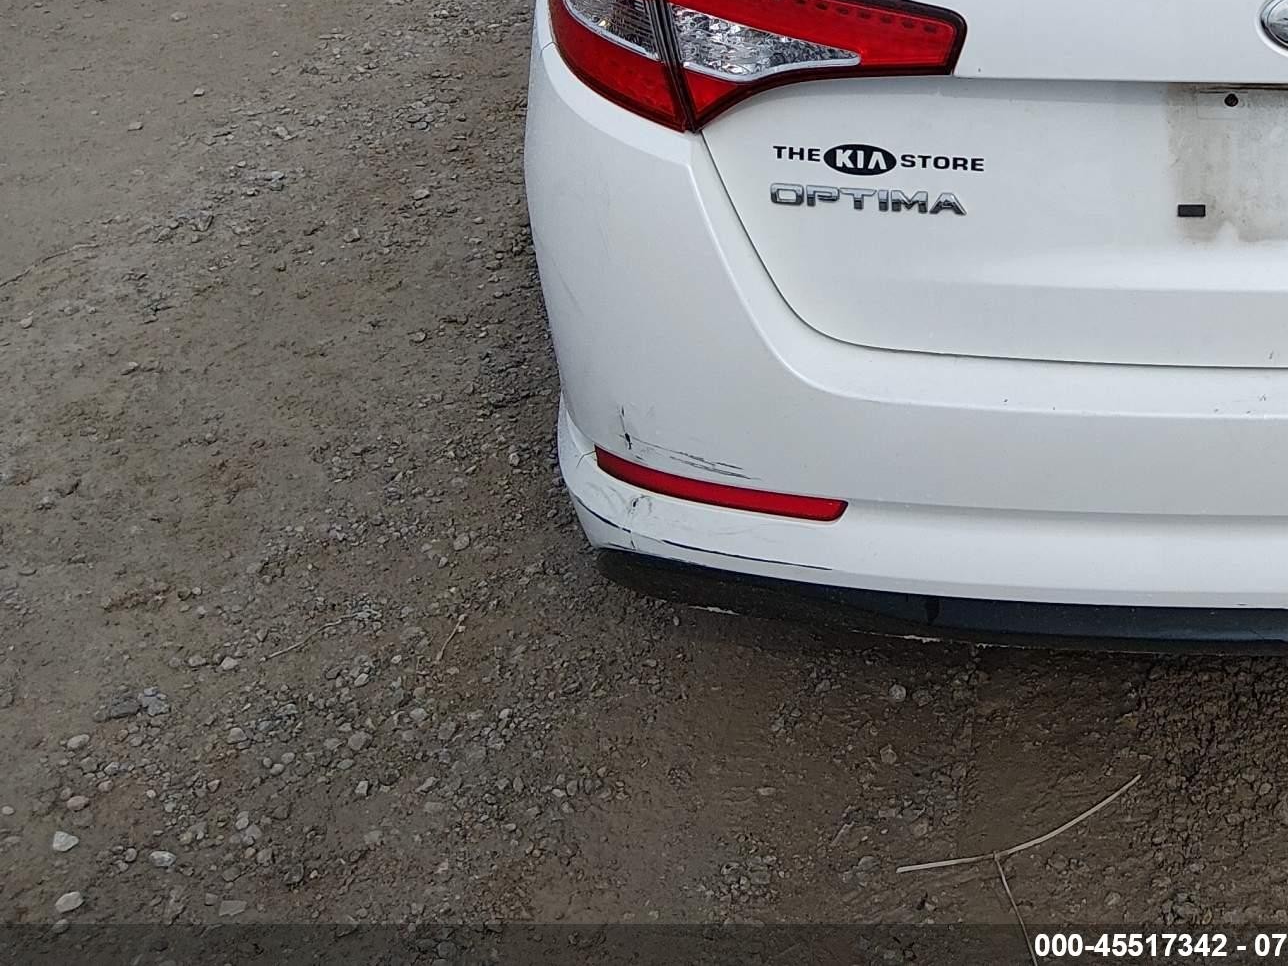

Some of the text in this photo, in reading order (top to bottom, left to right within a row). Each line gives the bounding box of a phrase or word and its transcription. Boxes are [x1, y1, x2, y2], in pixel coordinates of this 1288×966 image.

[773, 145, 985, 172] THE KIA STORE
[770, 183, 967, 216] OPTIMA
